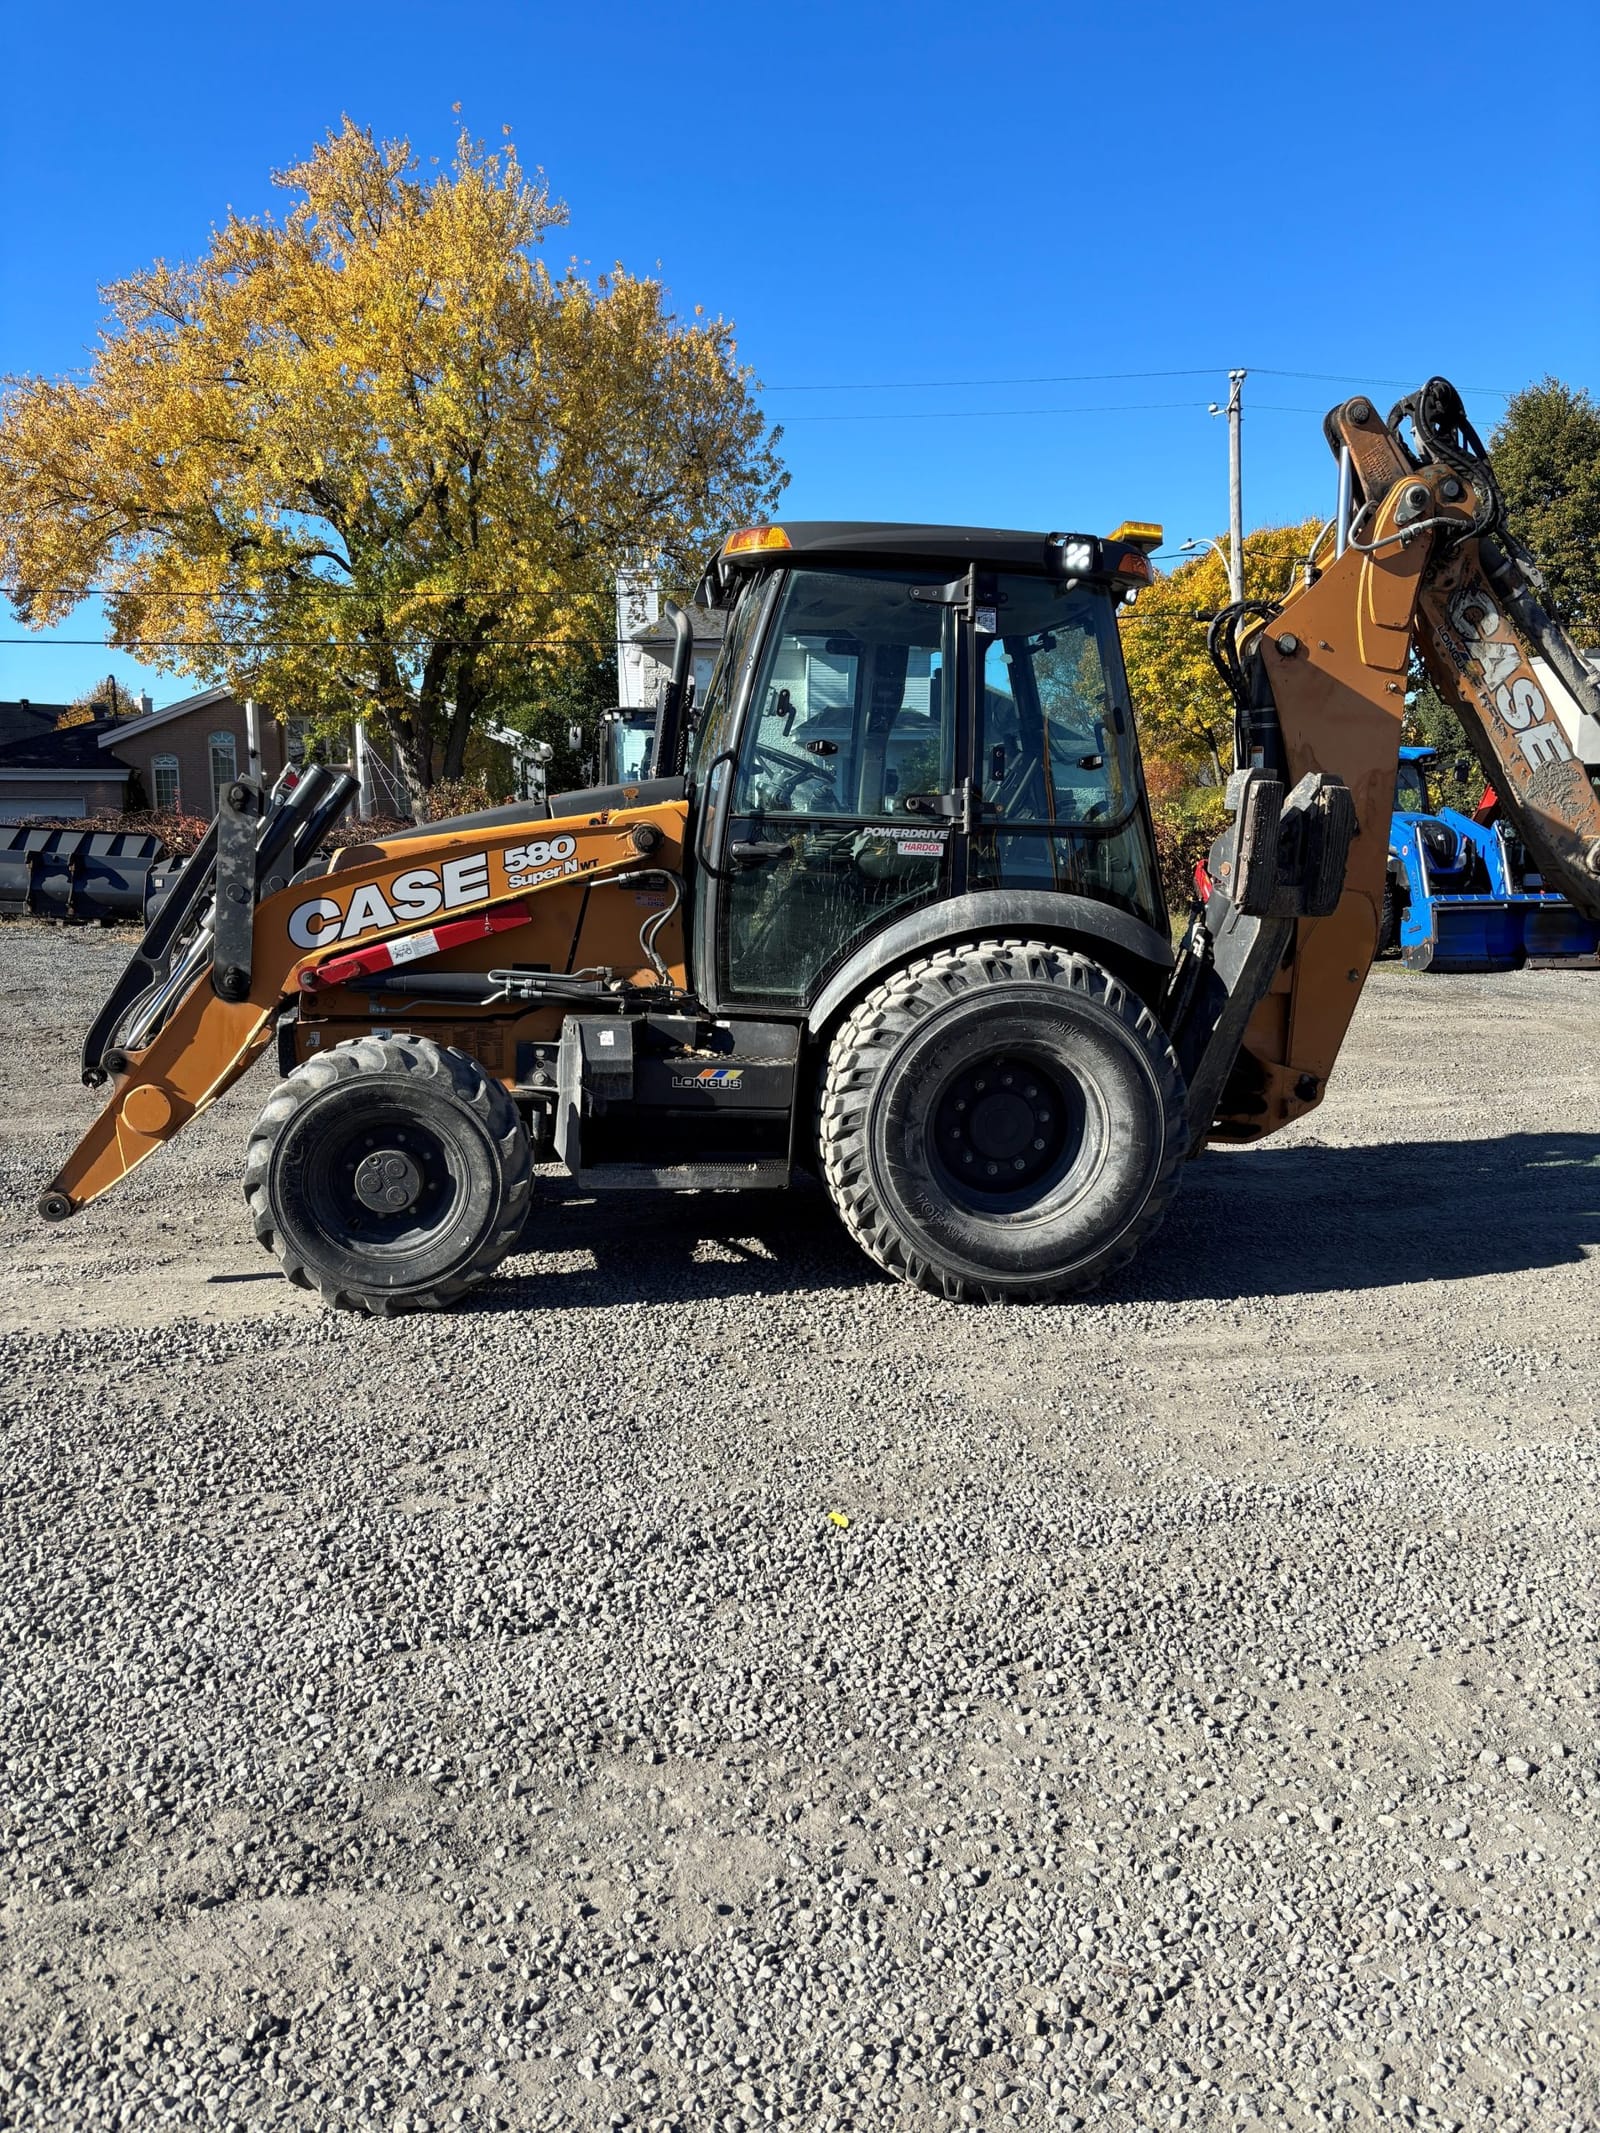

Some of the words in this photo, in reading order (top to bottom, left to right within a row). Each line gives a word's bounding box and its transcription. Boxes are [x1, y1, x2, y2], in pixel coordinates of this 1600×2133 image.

[1449, 582, 1576, 773] CASE
[862, 827, 950, 840] POWERDRIVE
[903, 842, 941, 852] HARDOX
[503, 834, 577, 873] 580
[508, 864, 563, 889] Super
[563, 858, 579, 875] N
[580, 858, 599, 872] WT
[287, 850, 489, 949] CASE
[671, 1076, 742, 1090] LONGUS
